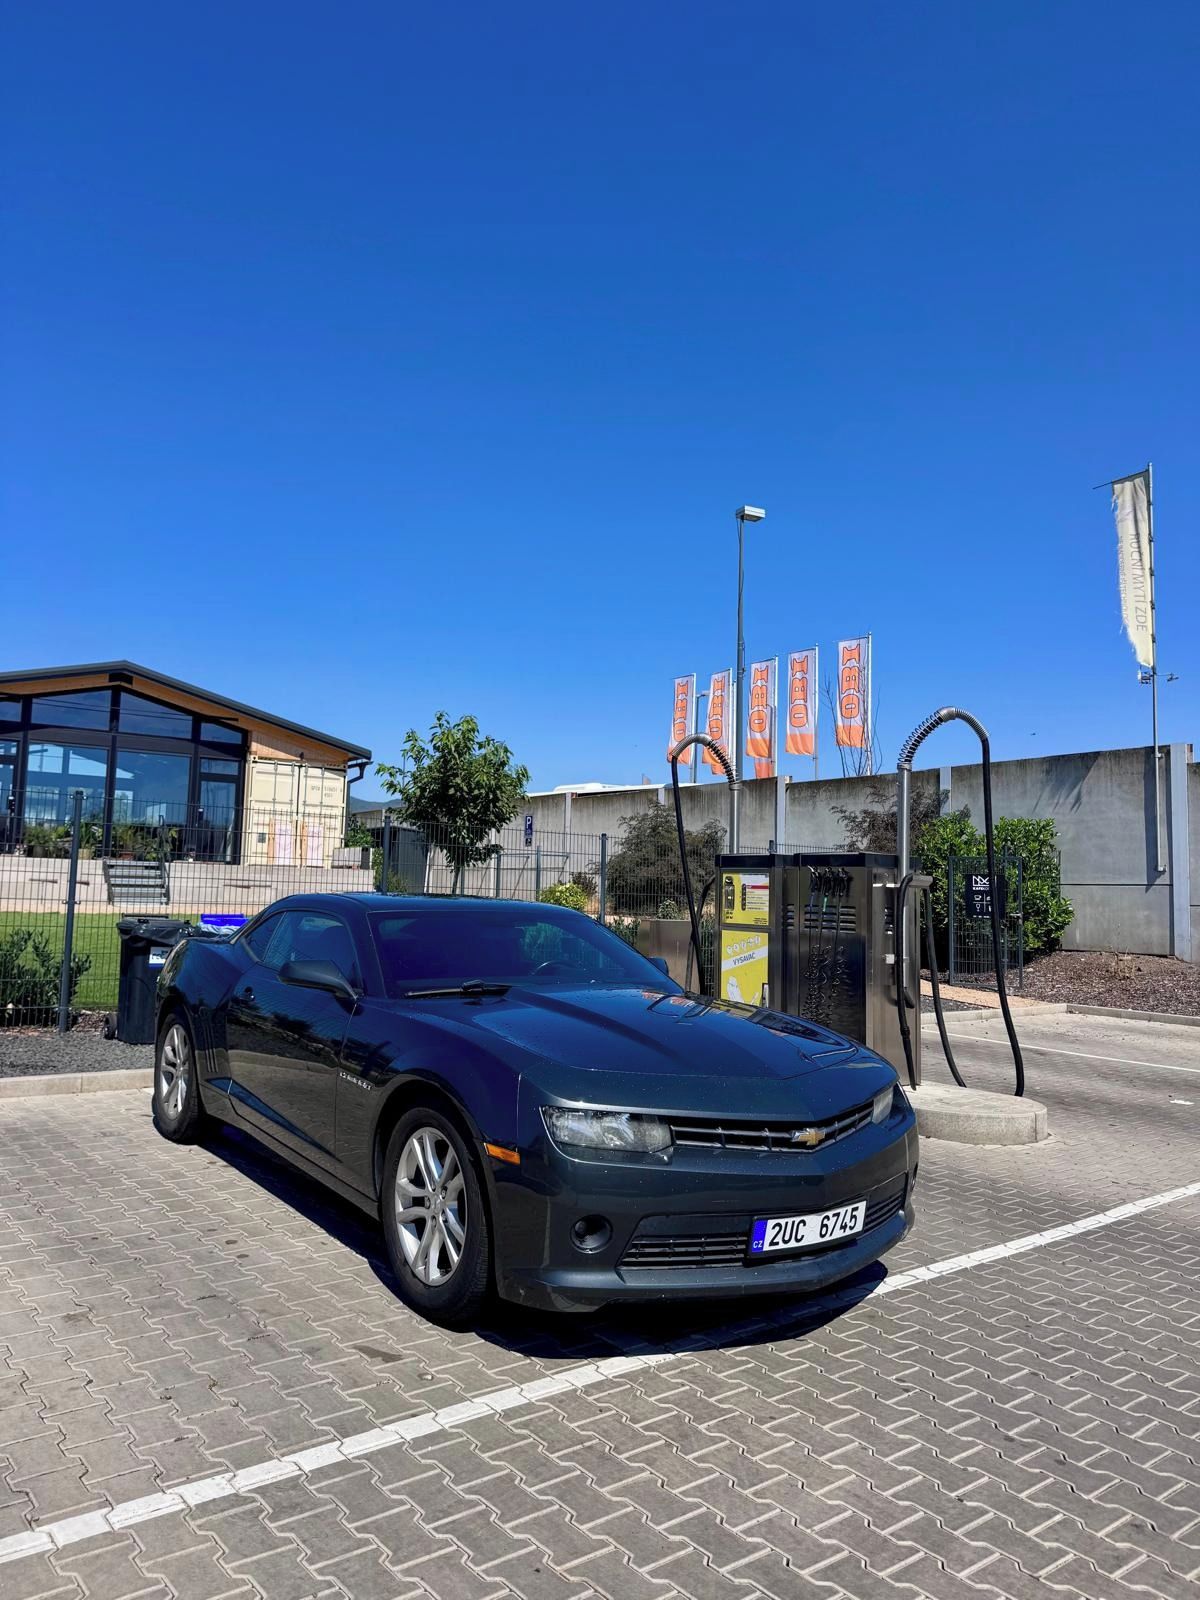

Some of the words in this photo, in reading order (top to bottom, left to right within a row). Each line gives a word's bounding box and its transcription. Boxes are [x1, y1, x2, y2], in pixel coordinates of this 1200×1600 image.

[1136, 607, 1148, 632] ZDE
[674, 681, 688, 742] OBI
[708, 676, 725, 740] OBI
[750, 664, 768, 733] OBI
[790, 655, 808, 728] OBI
[840, 644, 860, 719] OBI
[752, 1240, 763, 1249] CZ
[768, 1219, 807, 1247] 2UC
[819, 1206, 860, 1238] 6745
